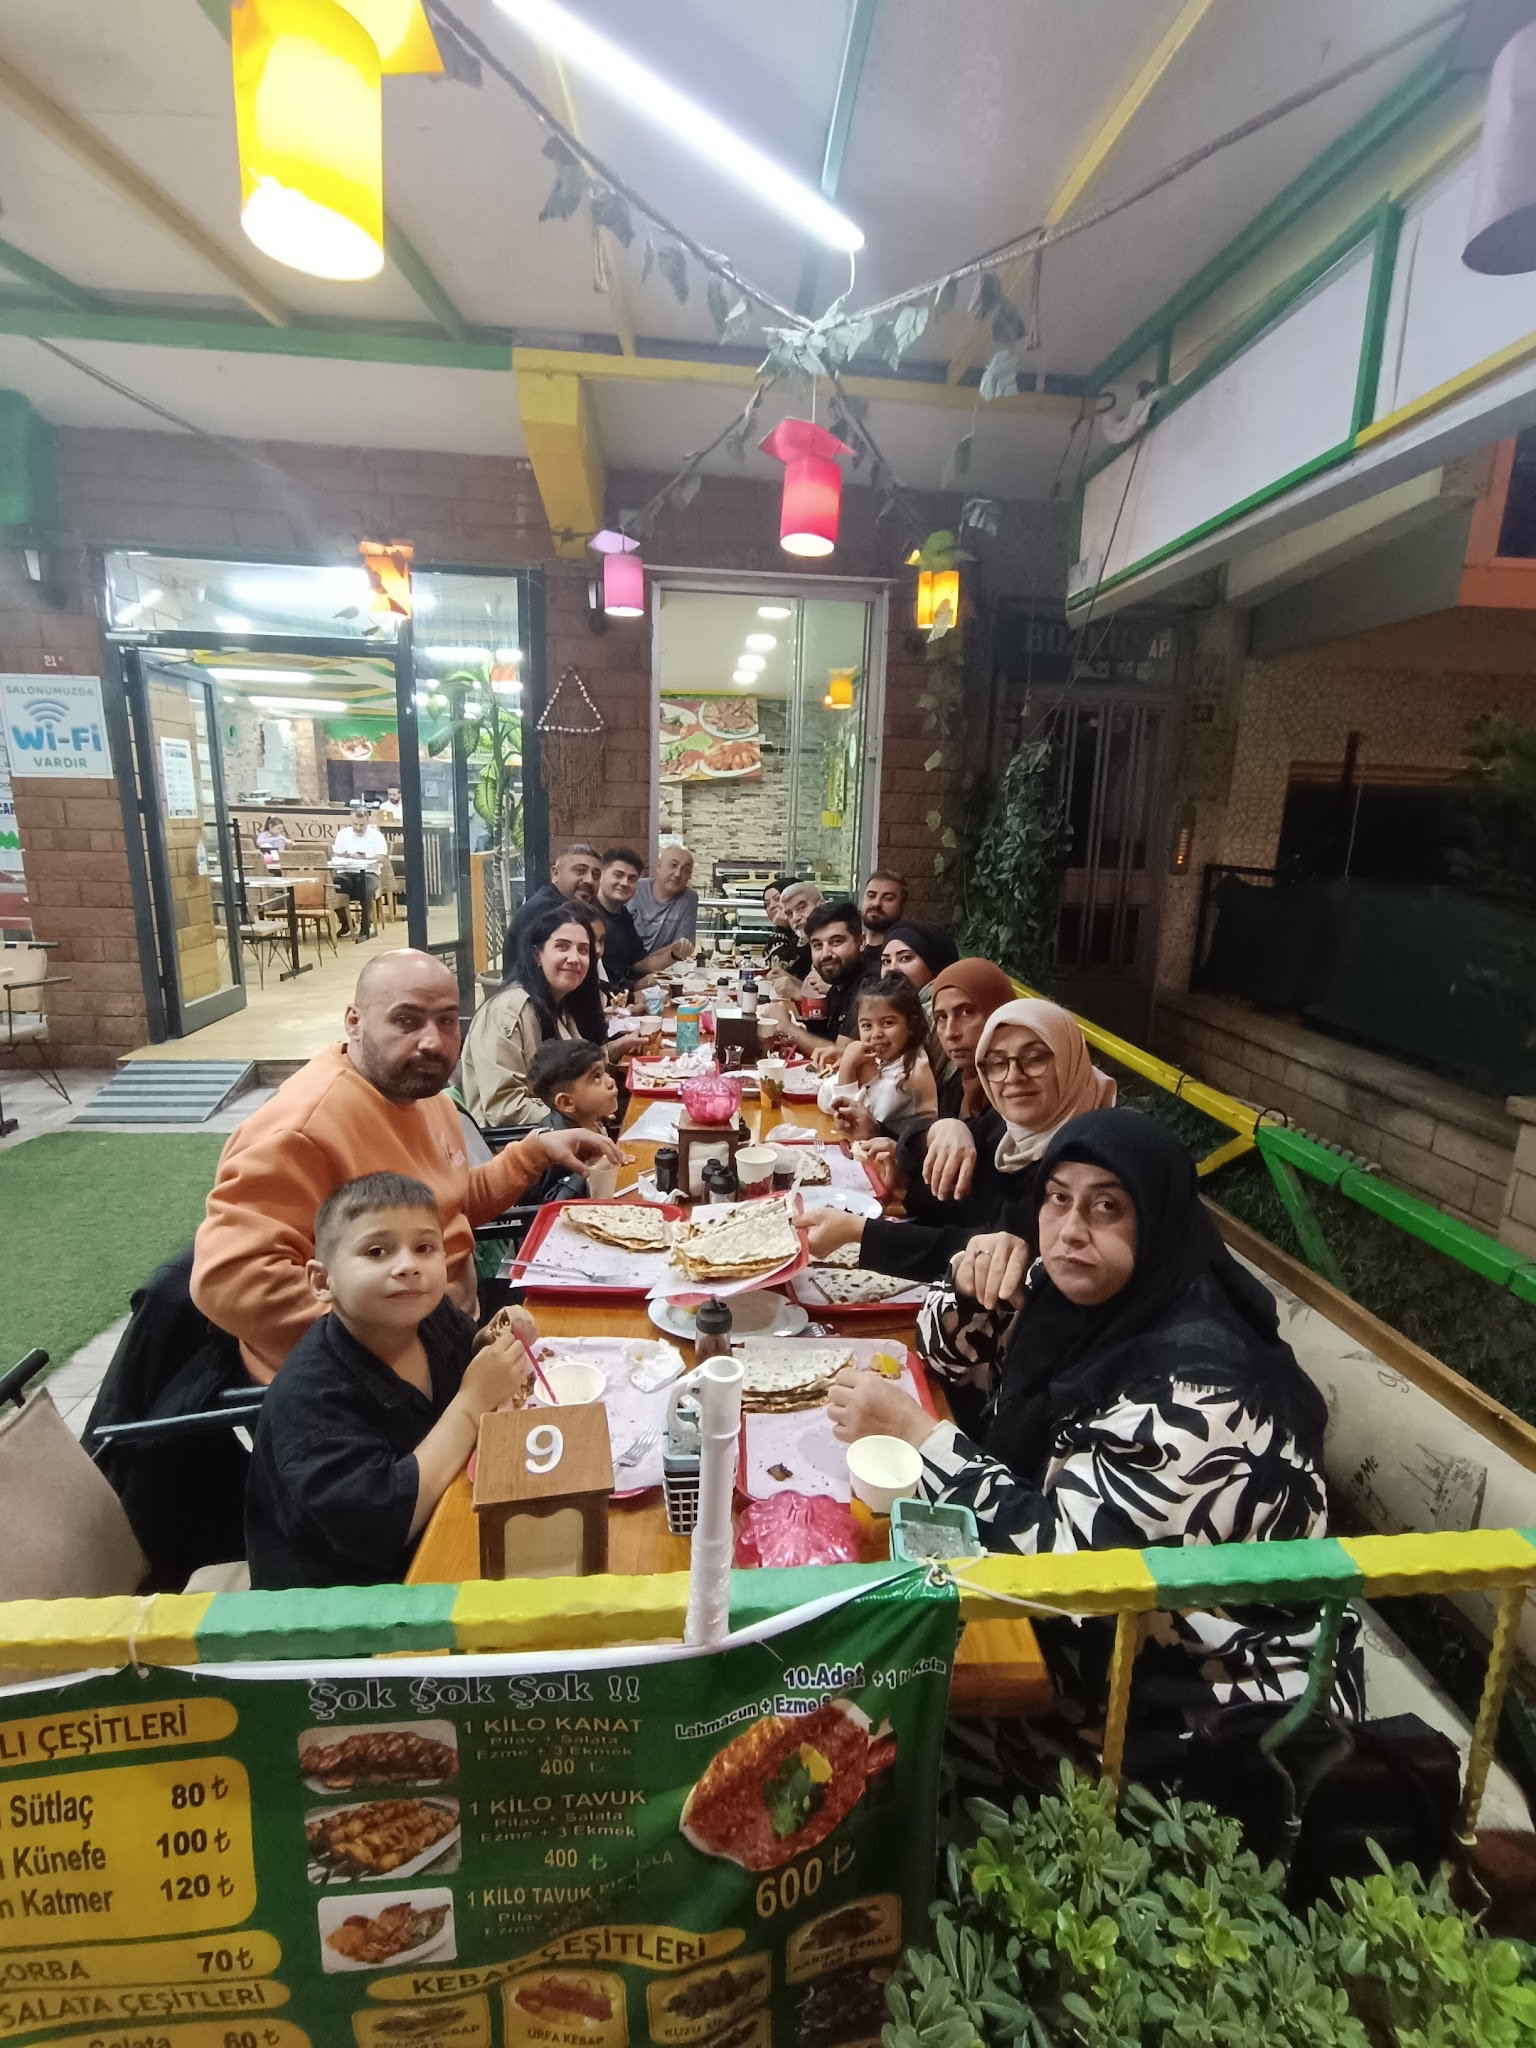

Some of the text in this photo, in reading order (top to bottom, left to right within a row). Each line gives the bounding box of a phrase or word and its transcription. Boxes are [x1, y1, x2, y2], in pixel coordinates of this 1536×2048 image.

[5, 685, 95, 697] SALONUMUZDA
[11, 722, 102, 752] Wi-Fi
[33, 757, 88, 769] VARDIR
[524, 1423, 565, 1475] 9
[886, 1669, 897, 1690] 1
[308, 1673, 641, 1721] Şok Şok Şok !!
[38, 1703, 188, 1760] ÇEŞİTLERİ
[462, 1716, 644, 1735] 1 KİLO KANAT
[675, 1704, 757, 1740] Lahmacun
[774, 1695, 818, 1717] Ezme
[540, 1758, 575, 1776] 400
[9, 1790, 94, 1830] Sütlaç
[171, 1782, 206, 1810] 80
[469, 1789, 648, 1817] 1 KİLO TAVUK
[558, 1827, 567, 1839] 3
[573, 1825, 637, 1838] Ekmek
[565, 1811, 623, 1824] Salata
[156, 1828, 208, 1859] 100
[543, 1848, 578, 1868] 400
[13, 1840, 107, 1880] Künefe
[160, 1873, 211, 1902] 120
[482, 1887, 526, 1908] KİLO
[532, 1886, 593, 1905] TAVUK
[755, 1857, 823, 1919] 600
[20, 1888, 113, 1918] Katmer
[540, 1928, 706, 1965] ÇEŞİTLERİ
[0, 1959, 91, 1988] ORBA
[0, 1983, 266, 2030] SALATA ÇEŞİTLERİ
